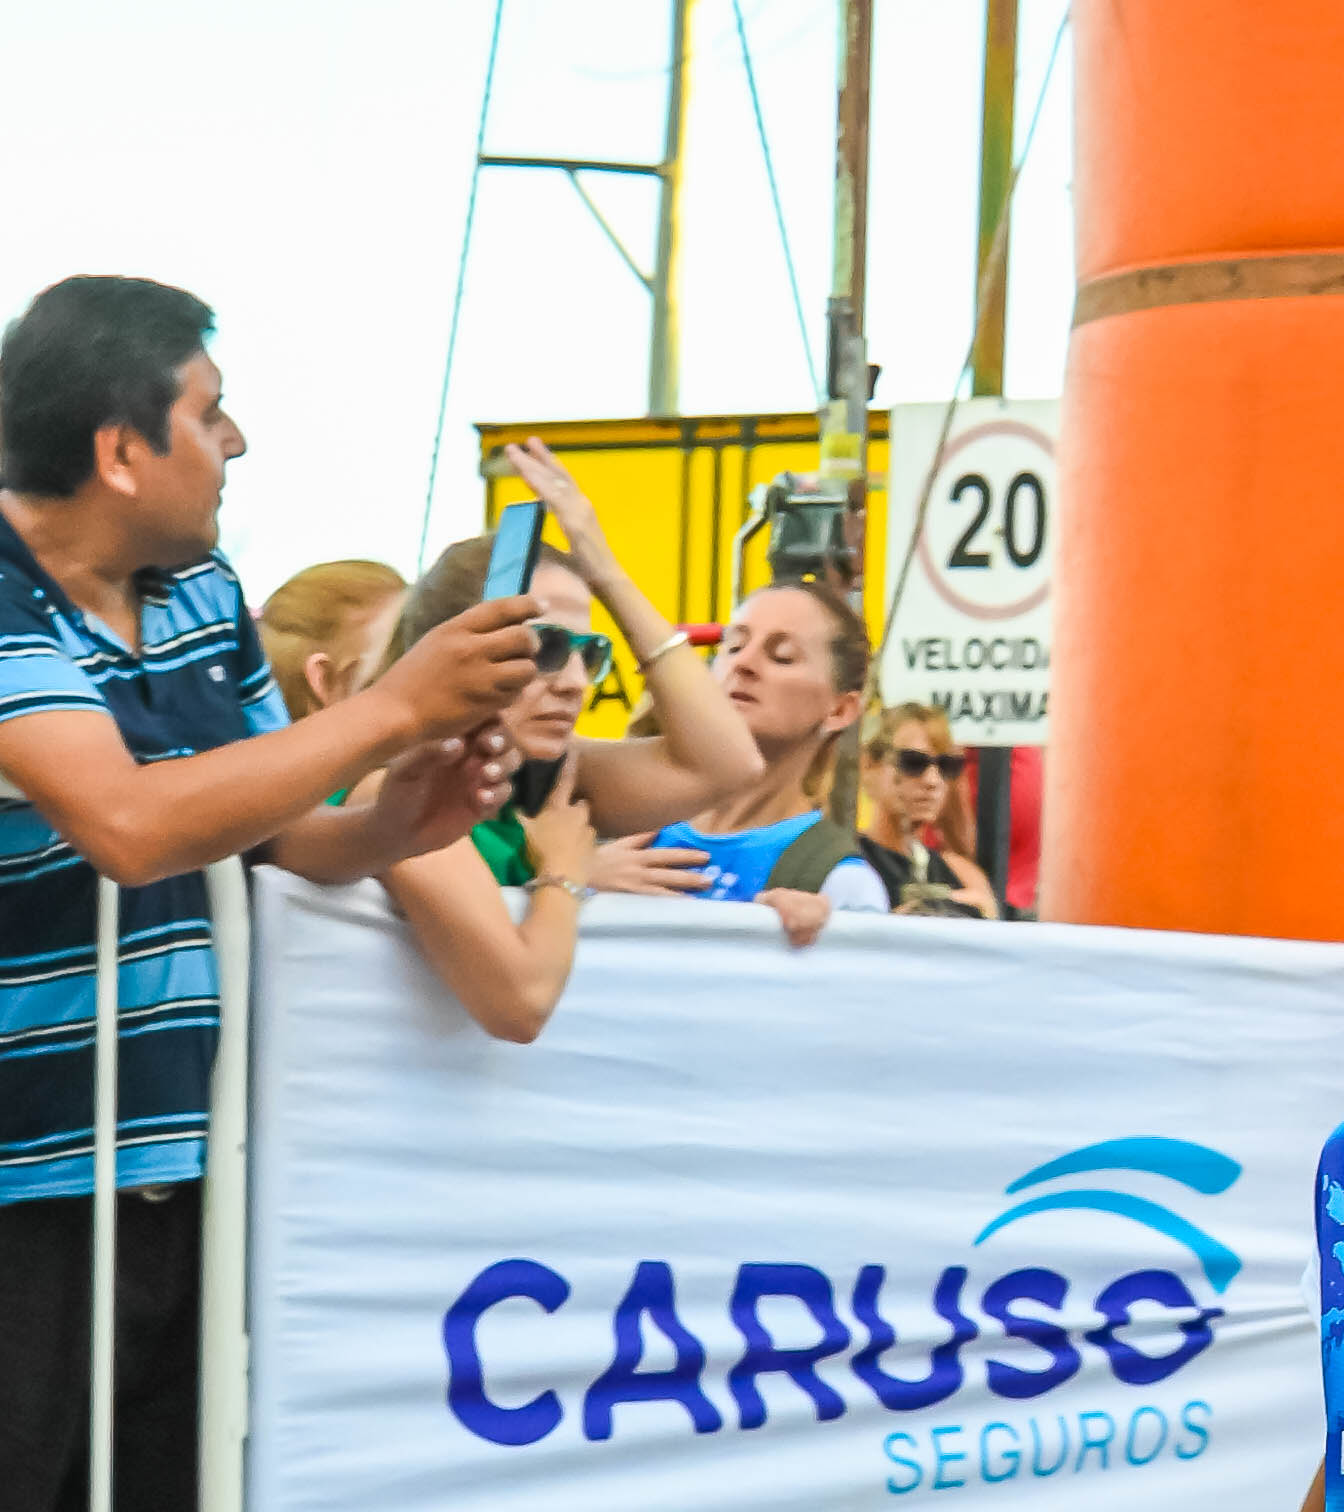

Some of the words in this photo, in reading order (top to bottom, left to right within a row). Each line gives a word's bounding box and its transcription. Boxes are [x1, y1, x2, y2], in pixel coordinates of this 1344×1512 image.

[949, 472, 1046, 568] 20
[444, 1257, 1224, 1446] CARUSO
[883, 1399, 1213, 1495] SEGUROS
